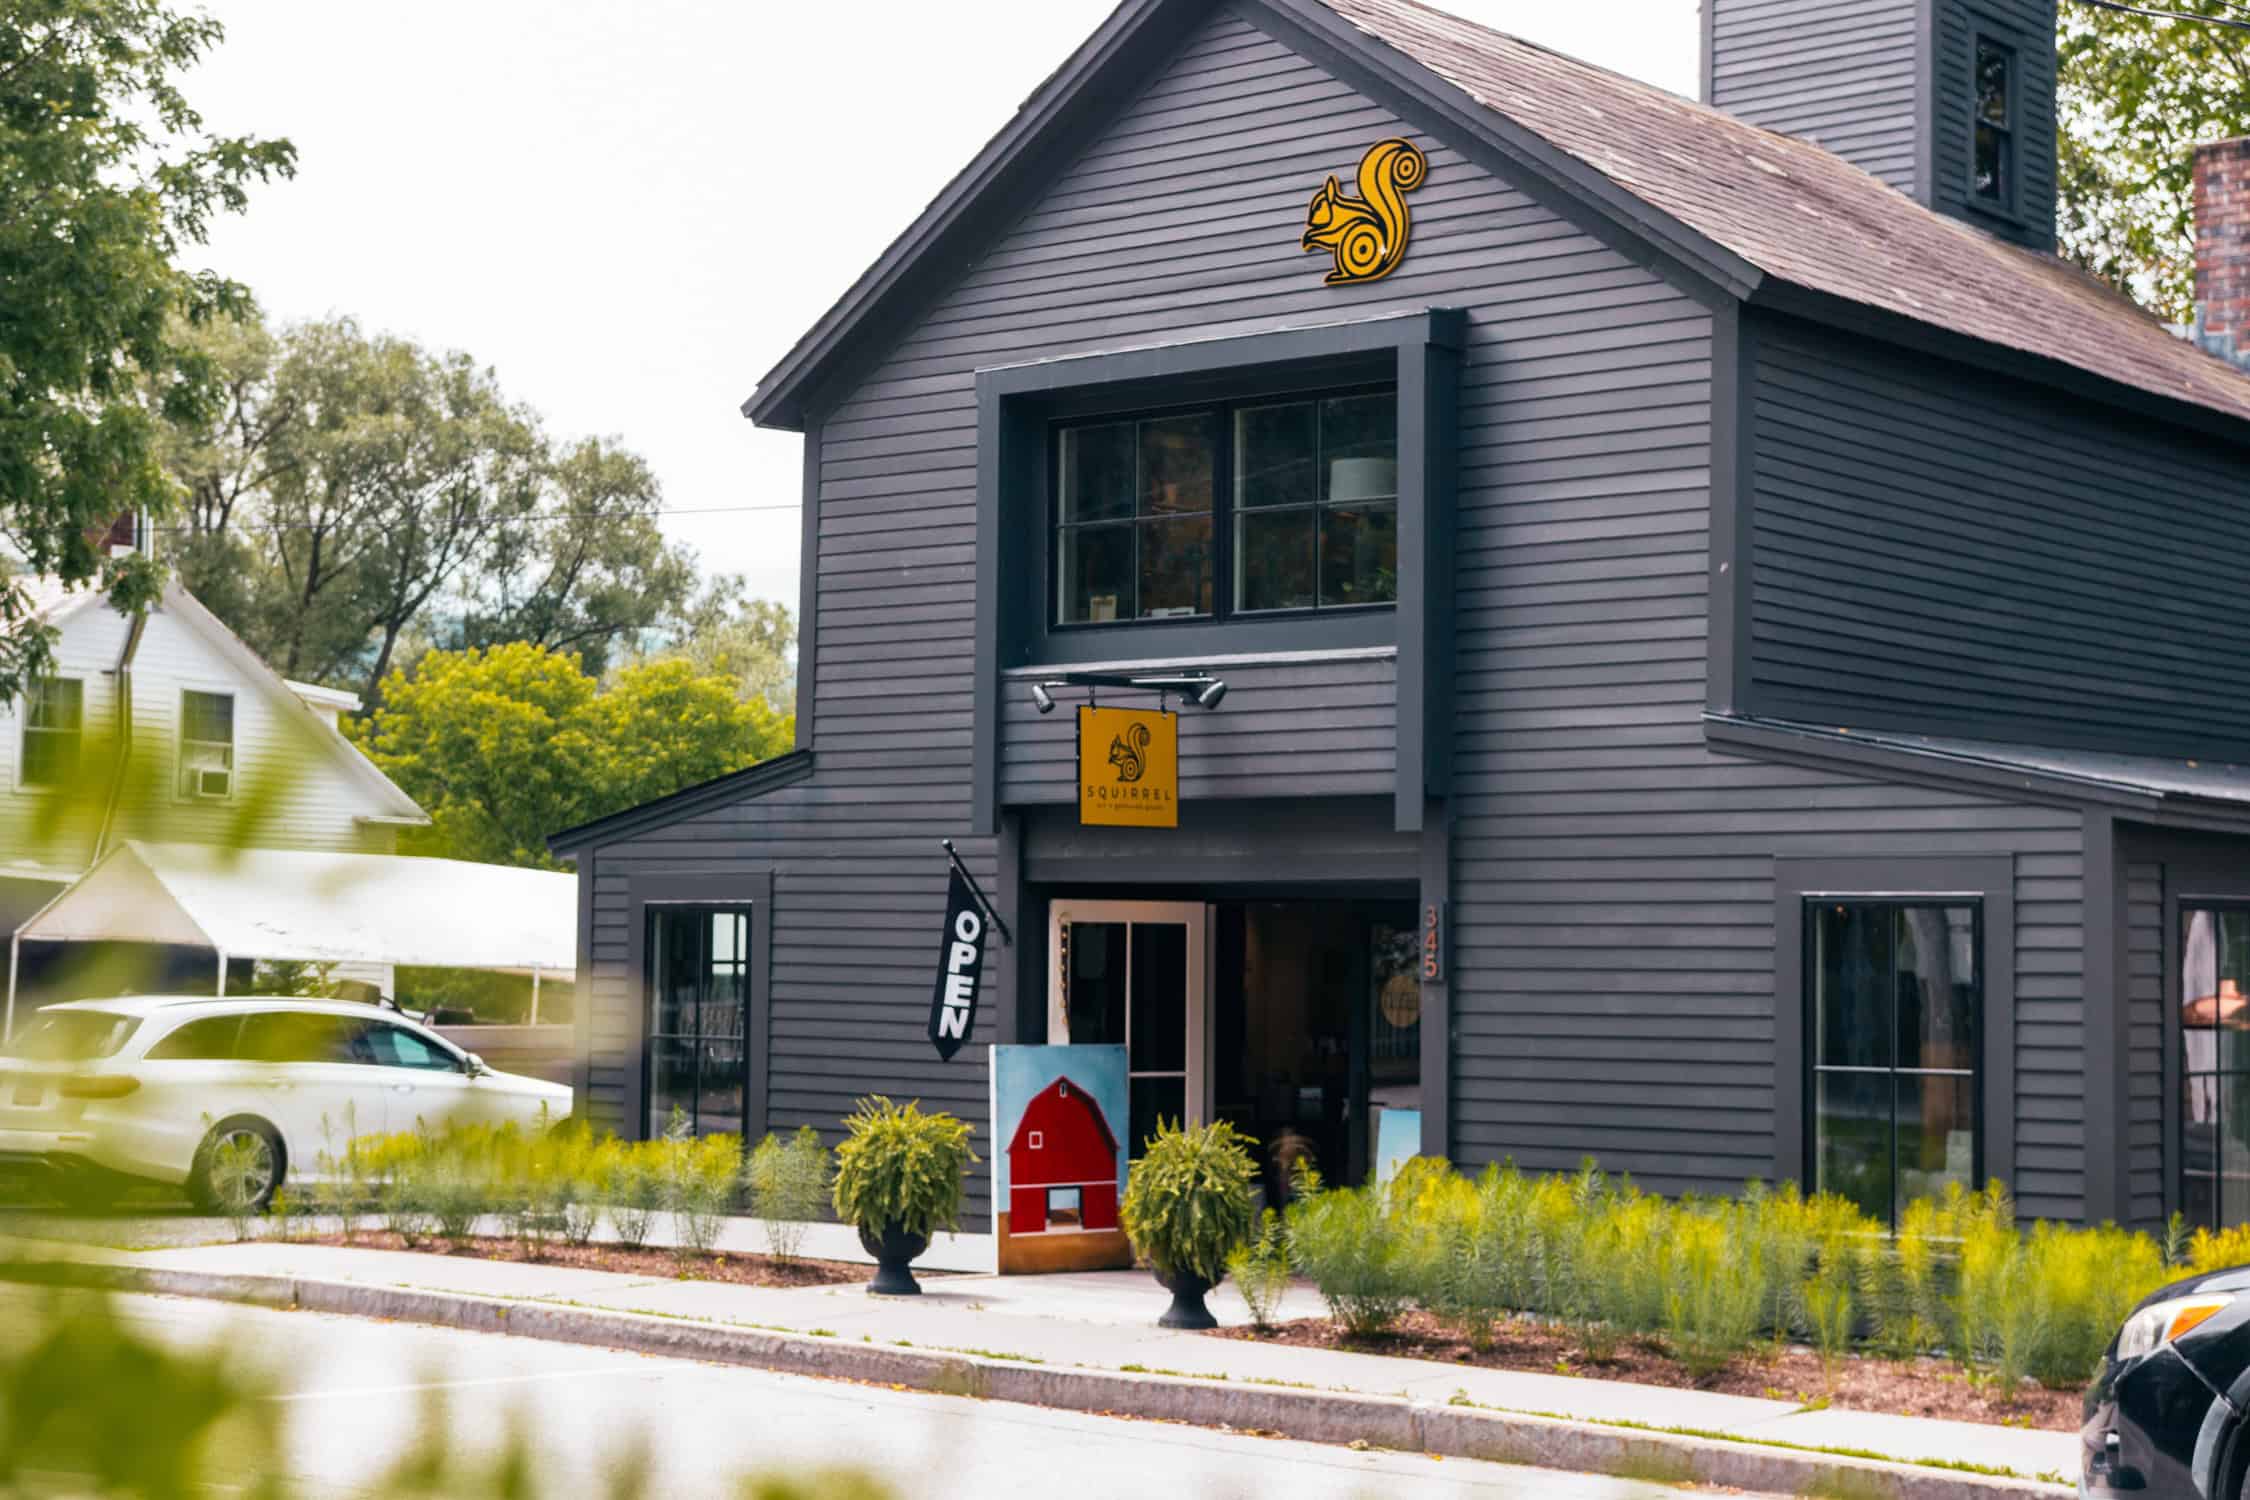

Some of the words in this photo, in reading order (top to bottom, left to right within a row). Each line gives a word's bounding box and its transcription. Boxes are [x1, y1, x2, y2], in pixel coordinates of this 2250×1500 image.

[1087, 784, 1171, 800] SQUIRREL
[938, 910, 981, 1039] OPEN
[1424, 904, 1437, 977] 345
